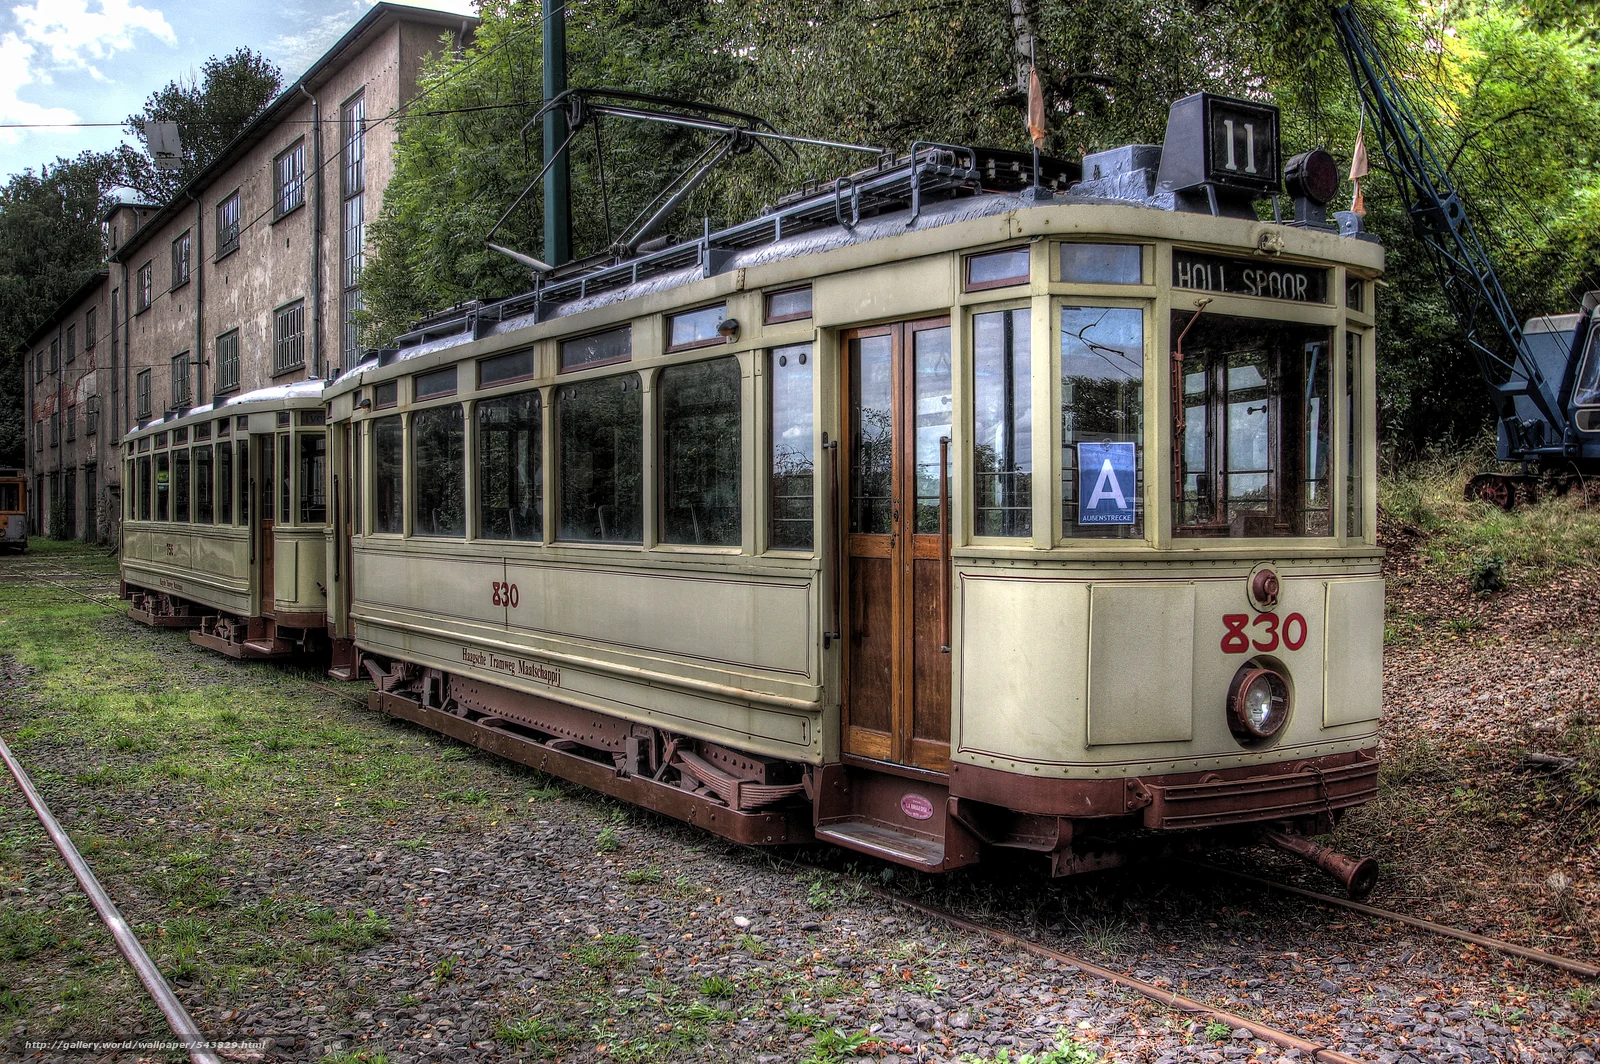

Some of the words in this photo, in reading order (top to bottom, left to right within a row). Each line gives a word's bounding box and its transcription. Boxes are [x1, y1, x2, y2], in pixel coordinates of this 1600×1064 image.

[1224, 120, 1257, 174] 11
[1242, 269, 1308, 301] SPOOR
[1086, 459, 1127, 508] A
[492, 582, 519, 608] 830
[1220, 612, 1308, 654] 830
[462, 648, 486, 665] Haagsche
[489, 653, 516, 676] Tramweg
[518, 659, 561, 687] Maatschappij
